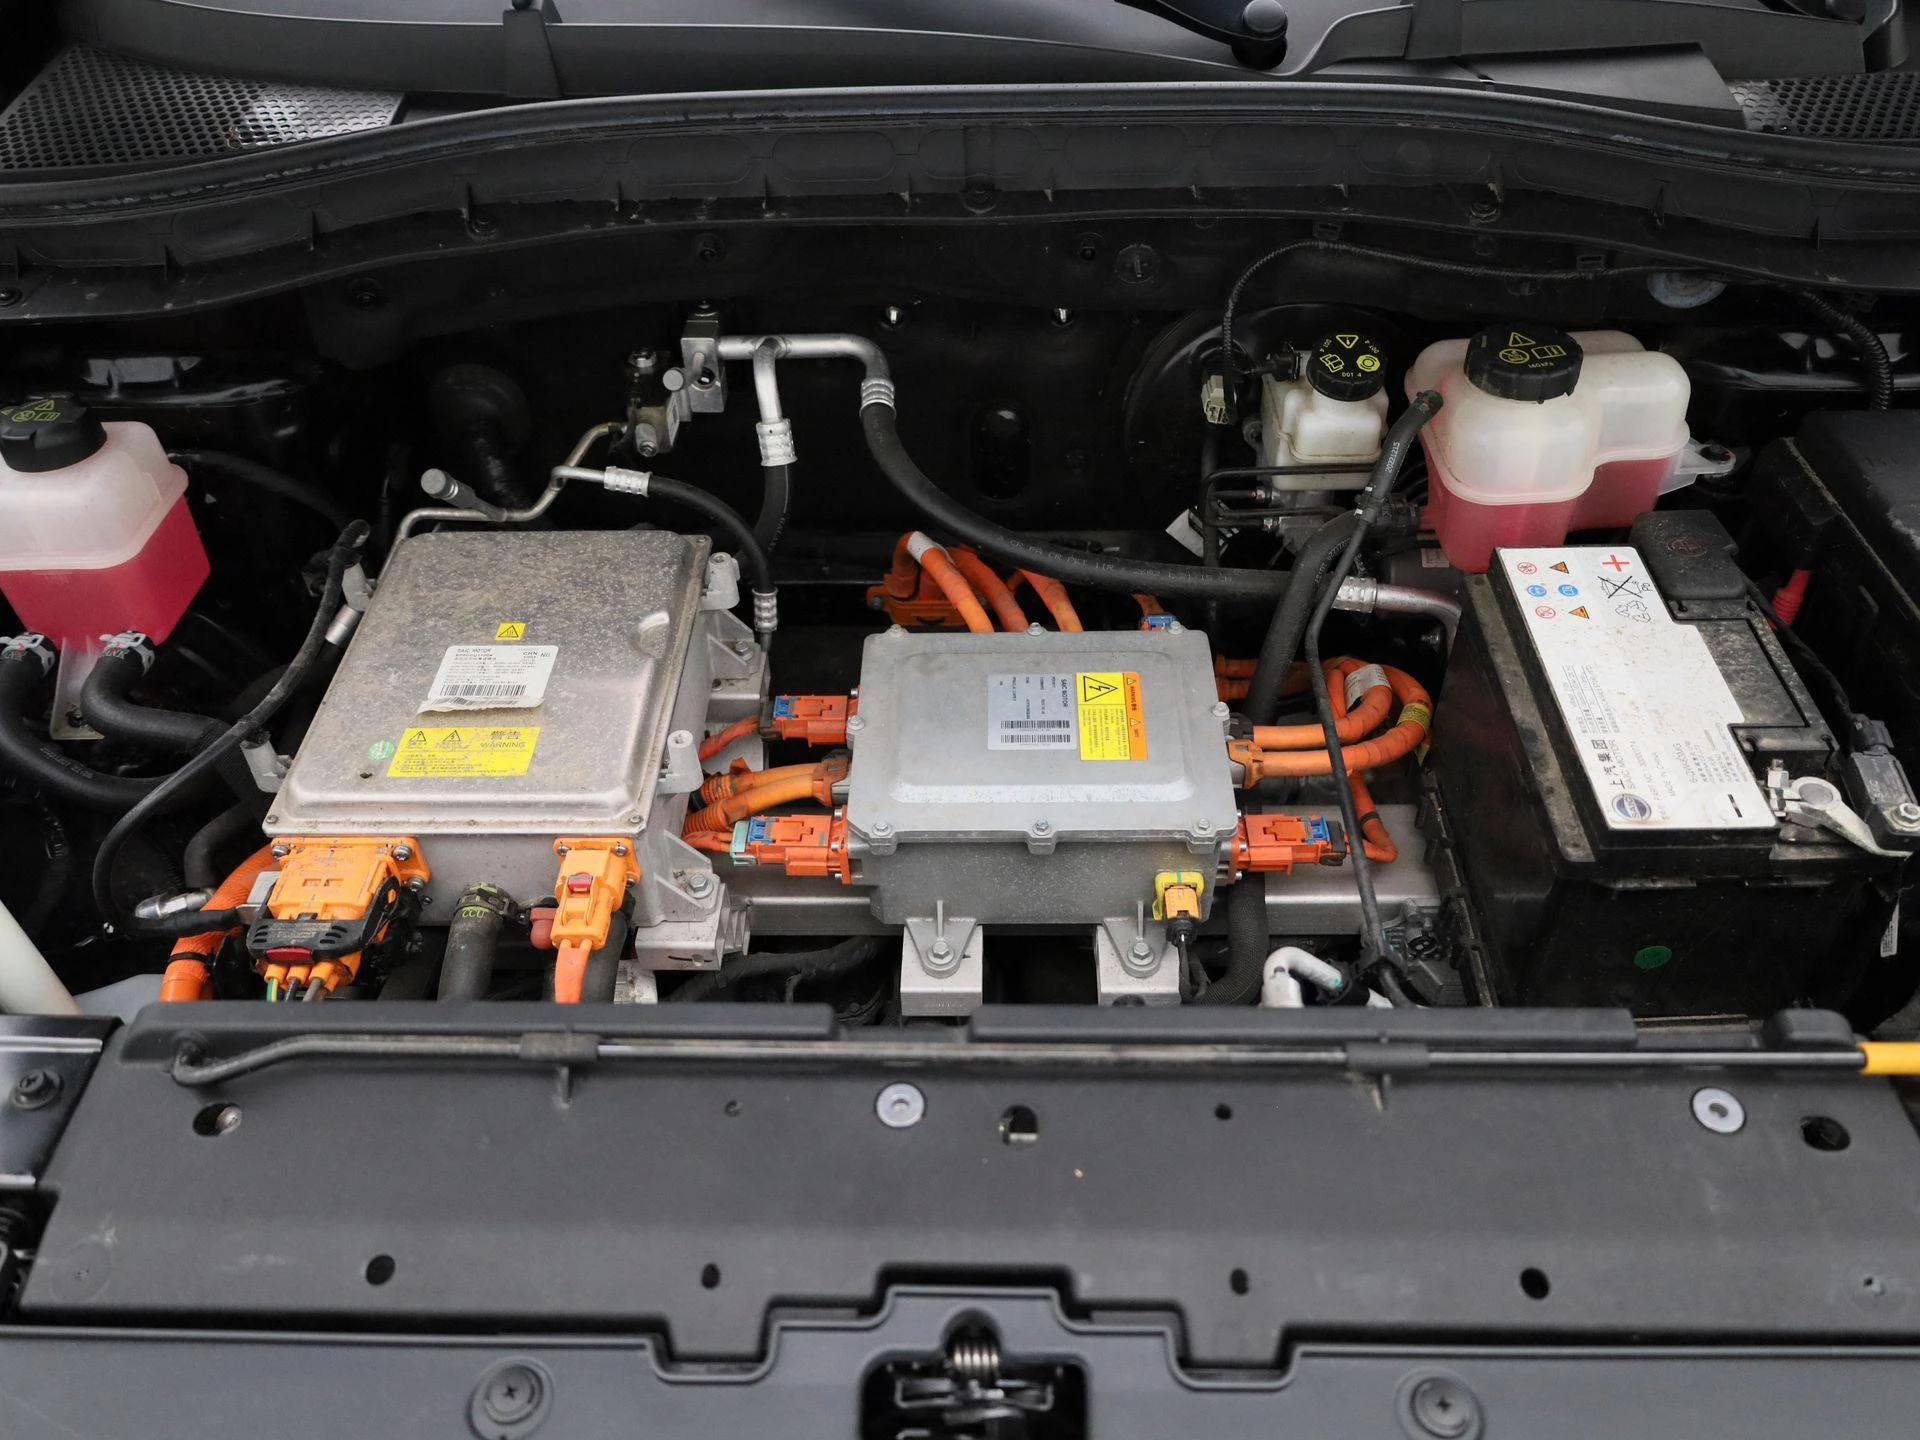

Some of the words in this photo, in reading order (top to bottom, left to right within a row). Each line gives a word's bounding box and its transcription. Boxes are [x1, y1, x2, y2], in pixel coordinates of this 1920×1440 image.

[480, 741, 526, 749] WARNING
[1608, 740, 1625, 768] MOTOR
[1591, 739, 1625, 790] 上汽集团
